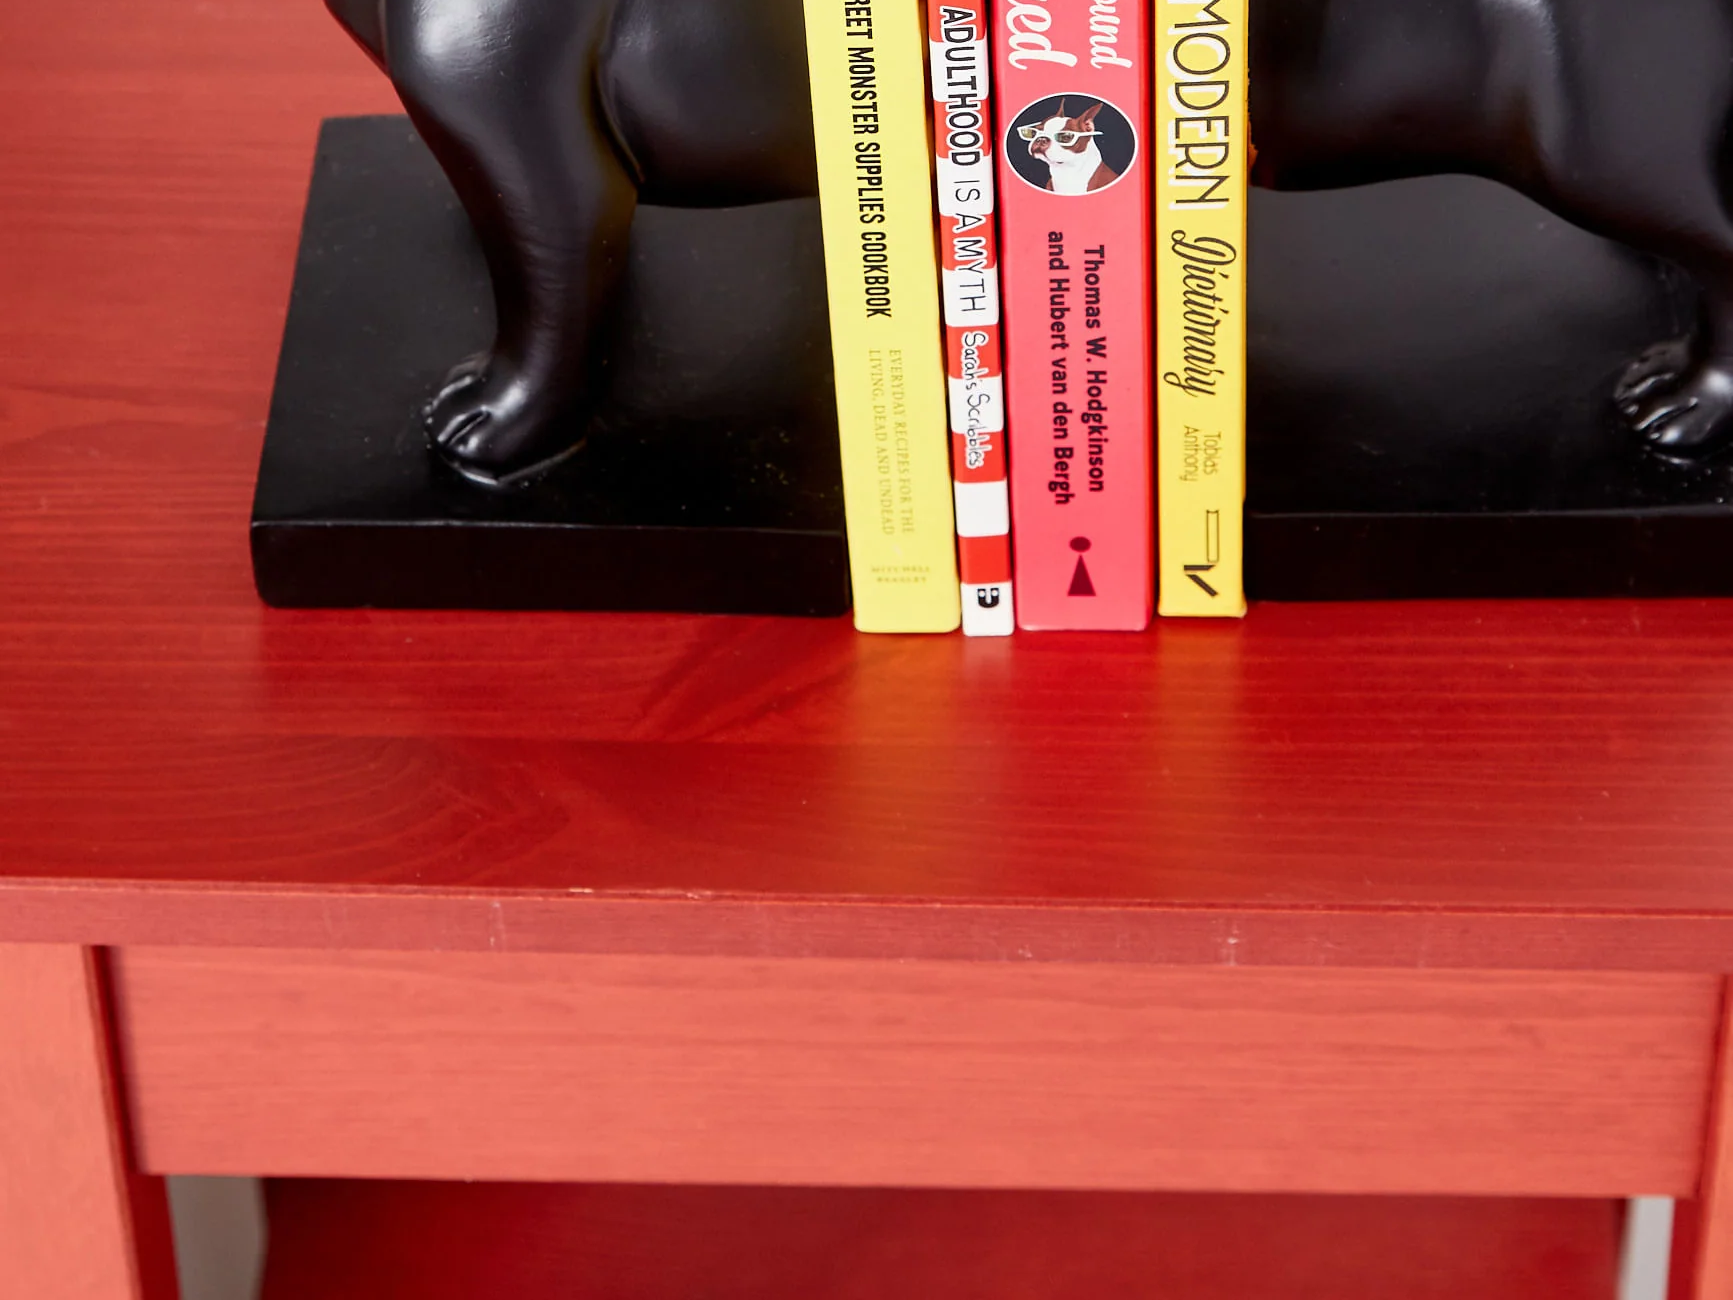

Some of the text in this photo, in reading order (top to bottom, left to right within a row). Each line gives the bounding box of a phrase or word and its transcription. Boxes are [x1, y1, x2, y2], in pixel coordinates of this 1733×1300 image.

[848, 47, 879, 135] MONSTER
[854, 141, 886, 224] SUPPLIES
[942, 7, 987, 312] ADULTHOOD IS A MYTH
[860, 231, 892, 318] COOKBOOK
[1163, 229, 1237, 398] Dictionary
[889, 349, 906, 417] EVERYDAY
[1048, 231, 1075, 505] and Hubert van den Bergh
[1081, 244, 1109, 492] Thomas W. Hodgkinson
[873, 405, 887, 441] DEAD
[876, 446, 890, 474] AND
[894, 421, 910, 474] RECIPES
[966, 393, 992, 467] Scribbles
[899, 478, 912, 504] FOR
